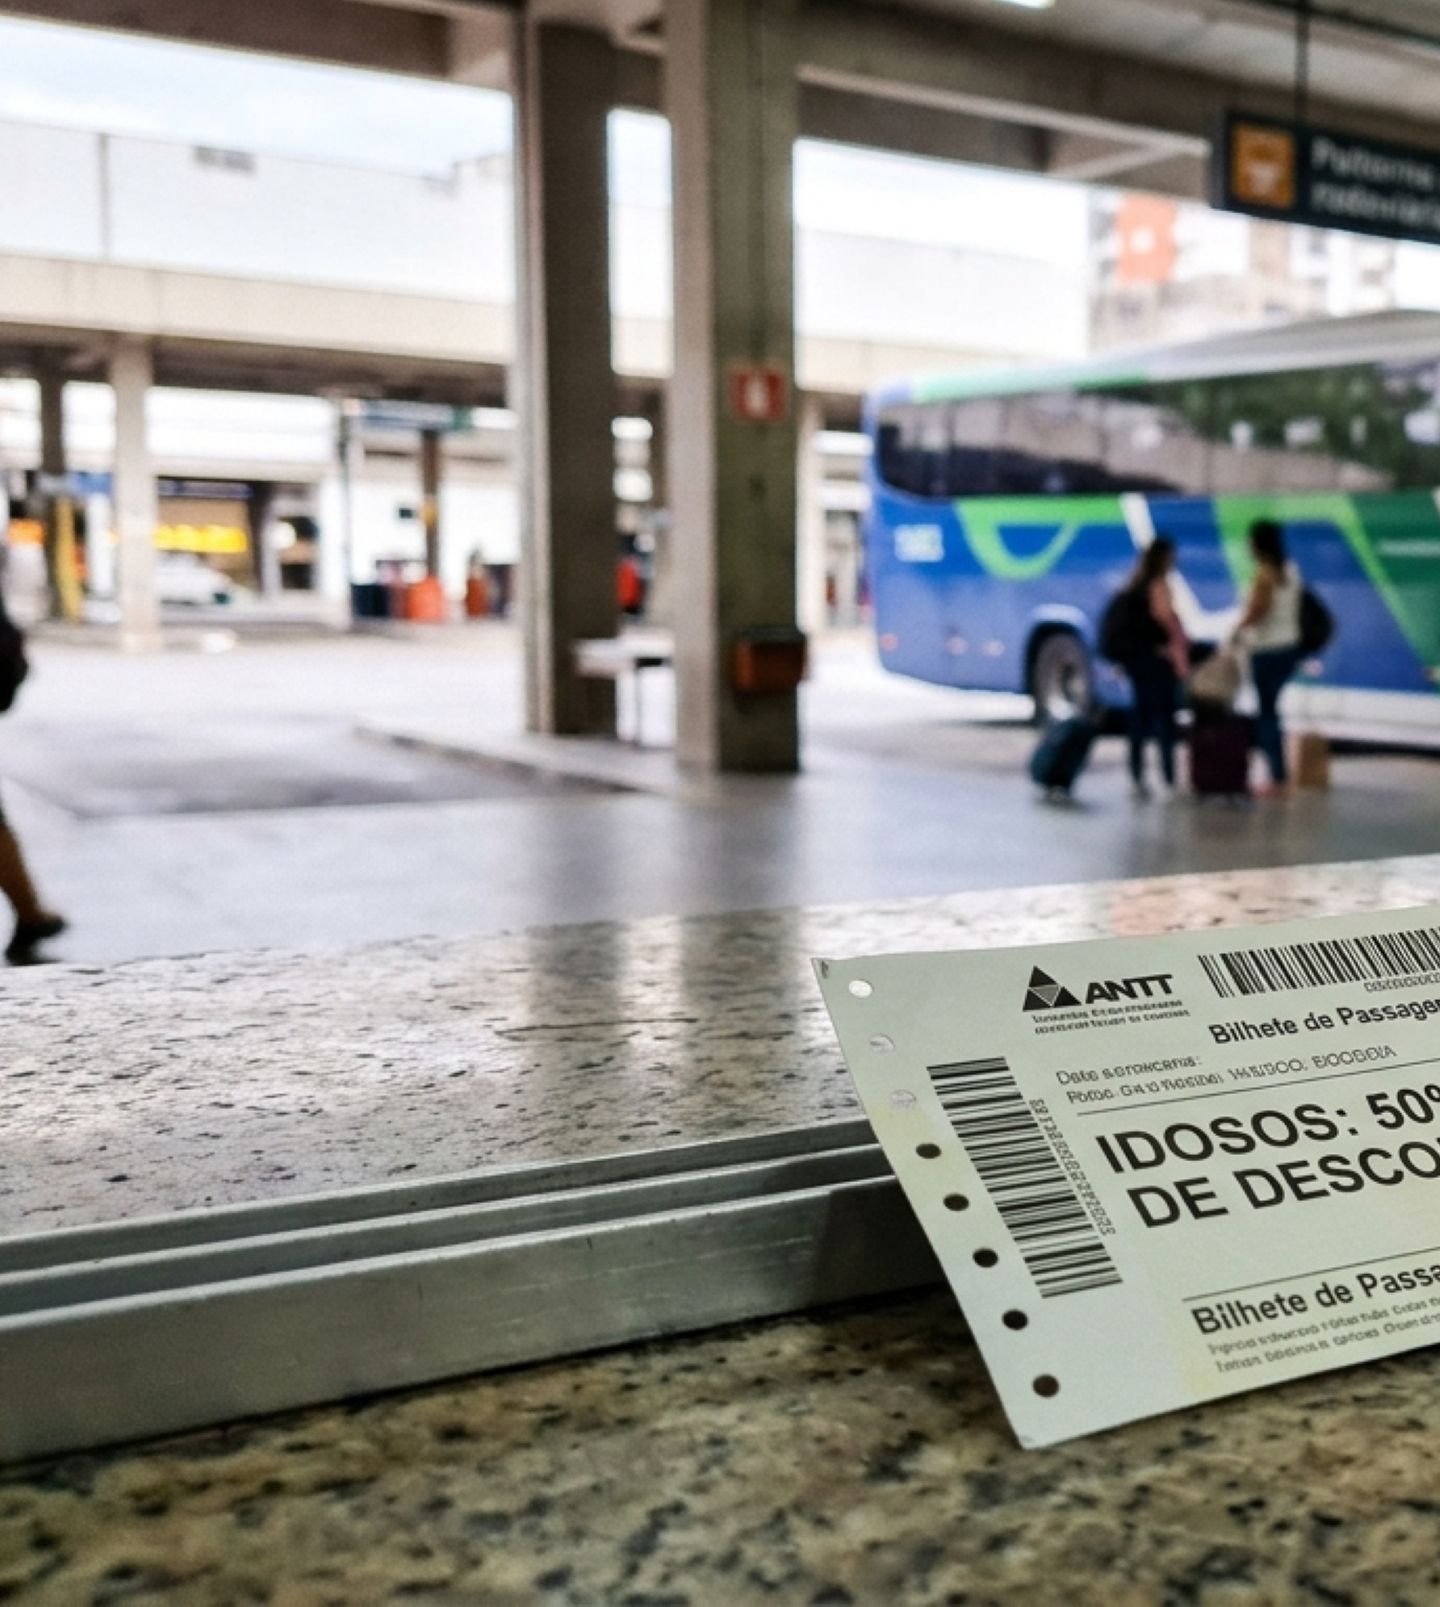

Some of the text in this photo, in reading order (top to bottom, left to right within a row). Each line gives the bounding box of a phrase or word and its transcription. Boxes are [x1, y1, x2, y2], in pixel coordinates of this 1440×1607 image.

[1085, 974, 1173, 1004] ANTT
[1208, 1017, 1299, 1044] Bilhete
[1303, 1012, 1336, 1032] de
[1095, 1103, 1359, 1174] IDOSOS:
[1127, 1177, 1230, 1229] DE
[1191, 1293, 1309, 1335] Bilhete
[1314, 1282, 1354, 1308] de
